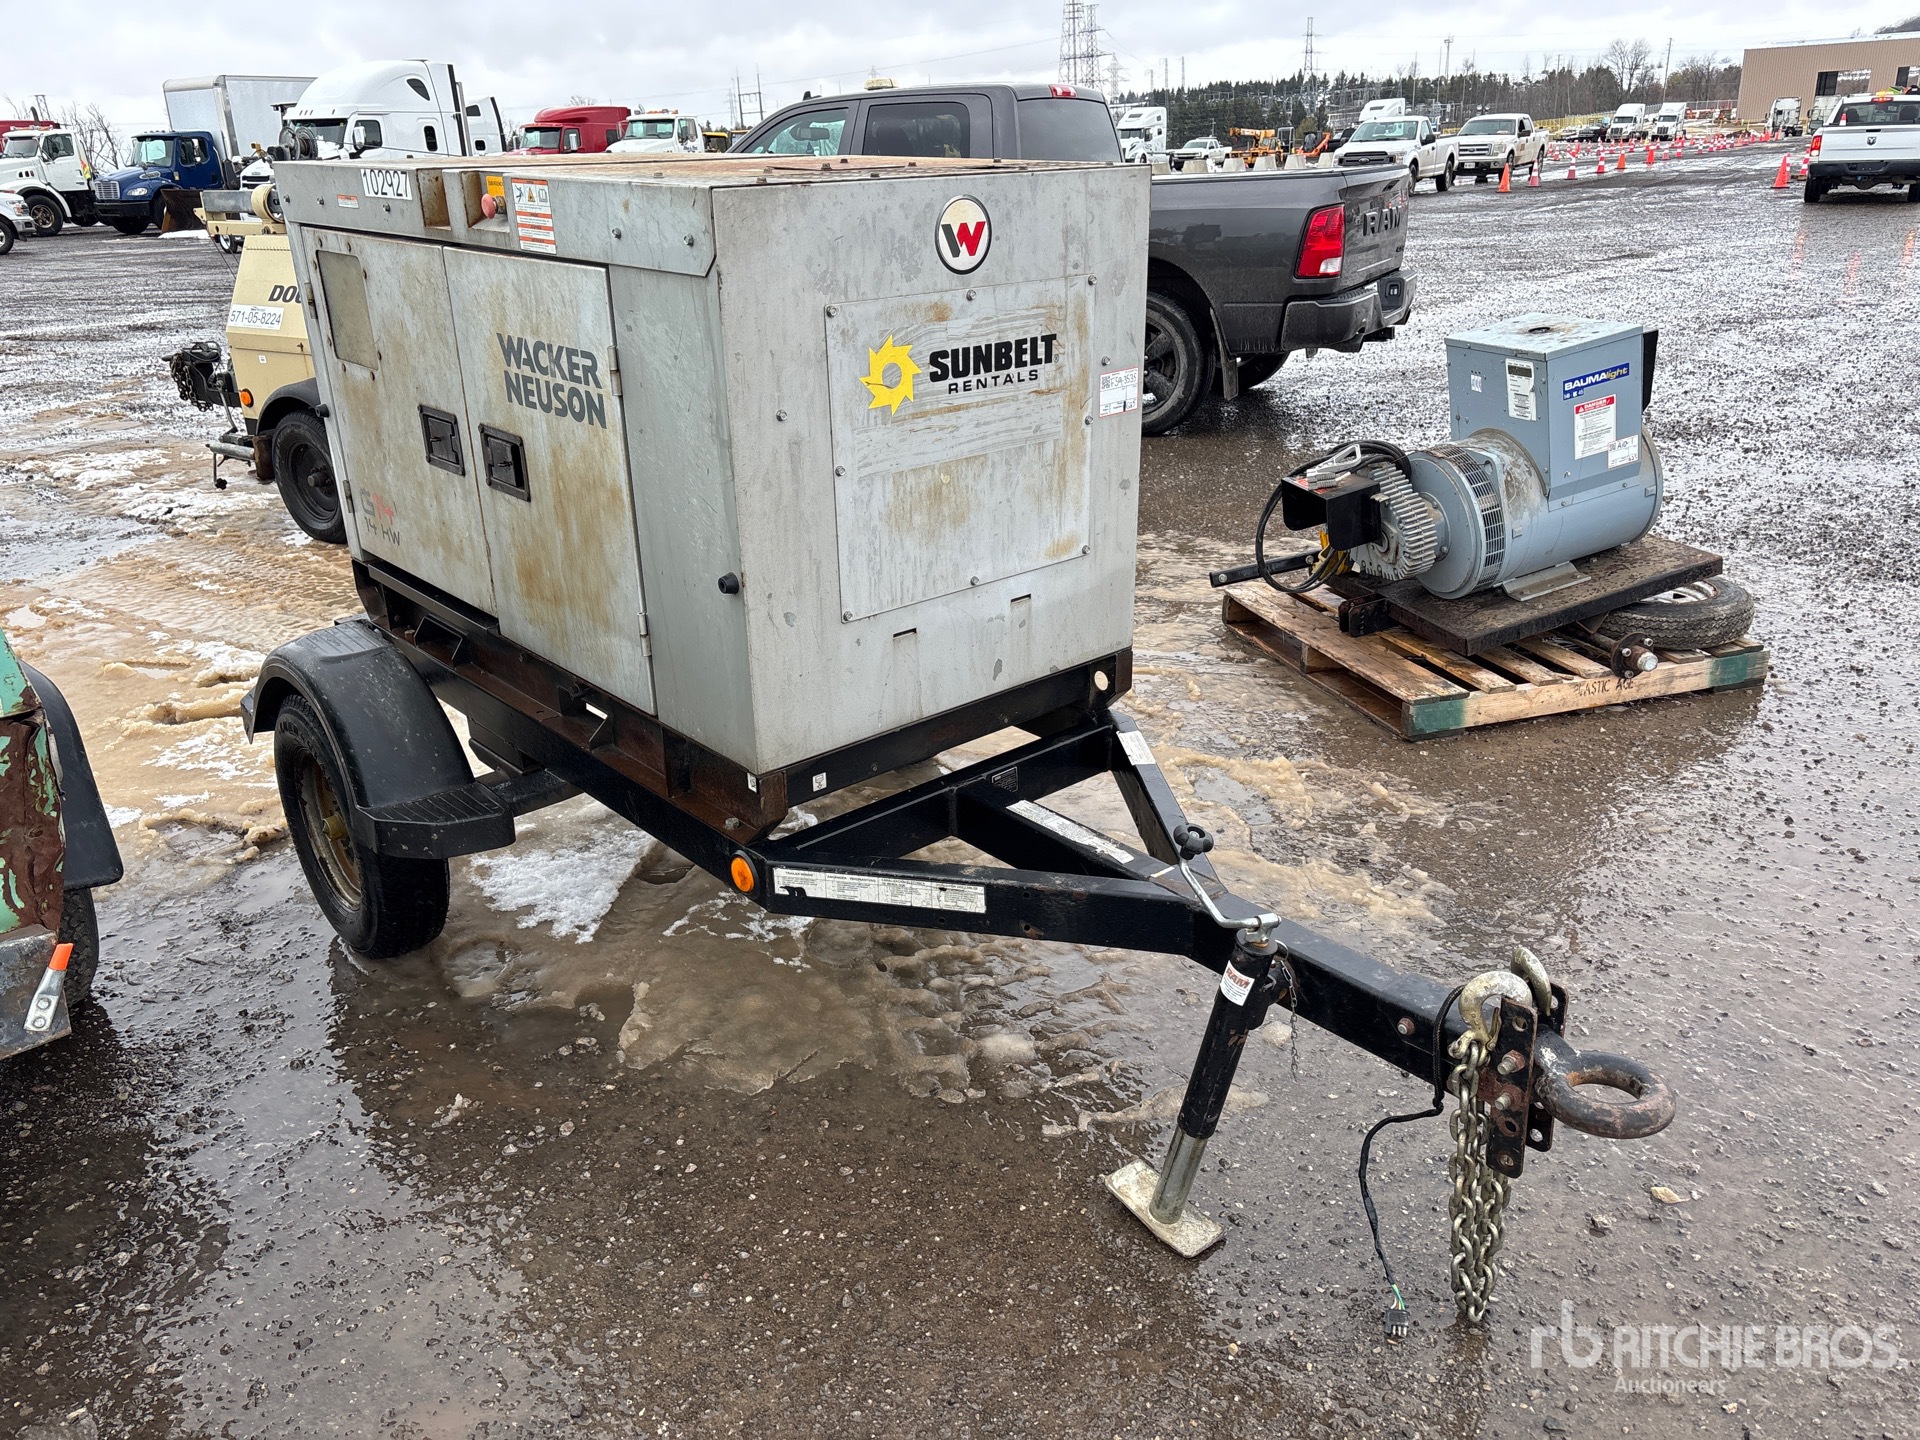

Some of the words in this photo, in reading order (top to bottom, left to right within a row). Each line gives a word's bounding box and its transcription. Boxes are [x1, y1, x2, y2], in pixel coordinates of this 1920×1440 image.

[362, 168, 408, 198] 102927
[1362, 205, 1402, 237] RAM
[230, 310, 281, 326] 571-05-8224
[496, 332, 602, 389] WACKER
[929, 333, 1057, 383] SUNBELT
[948, 369, 1039, 395] RENTALS
[503, 369, 607, 430] NEUSON
